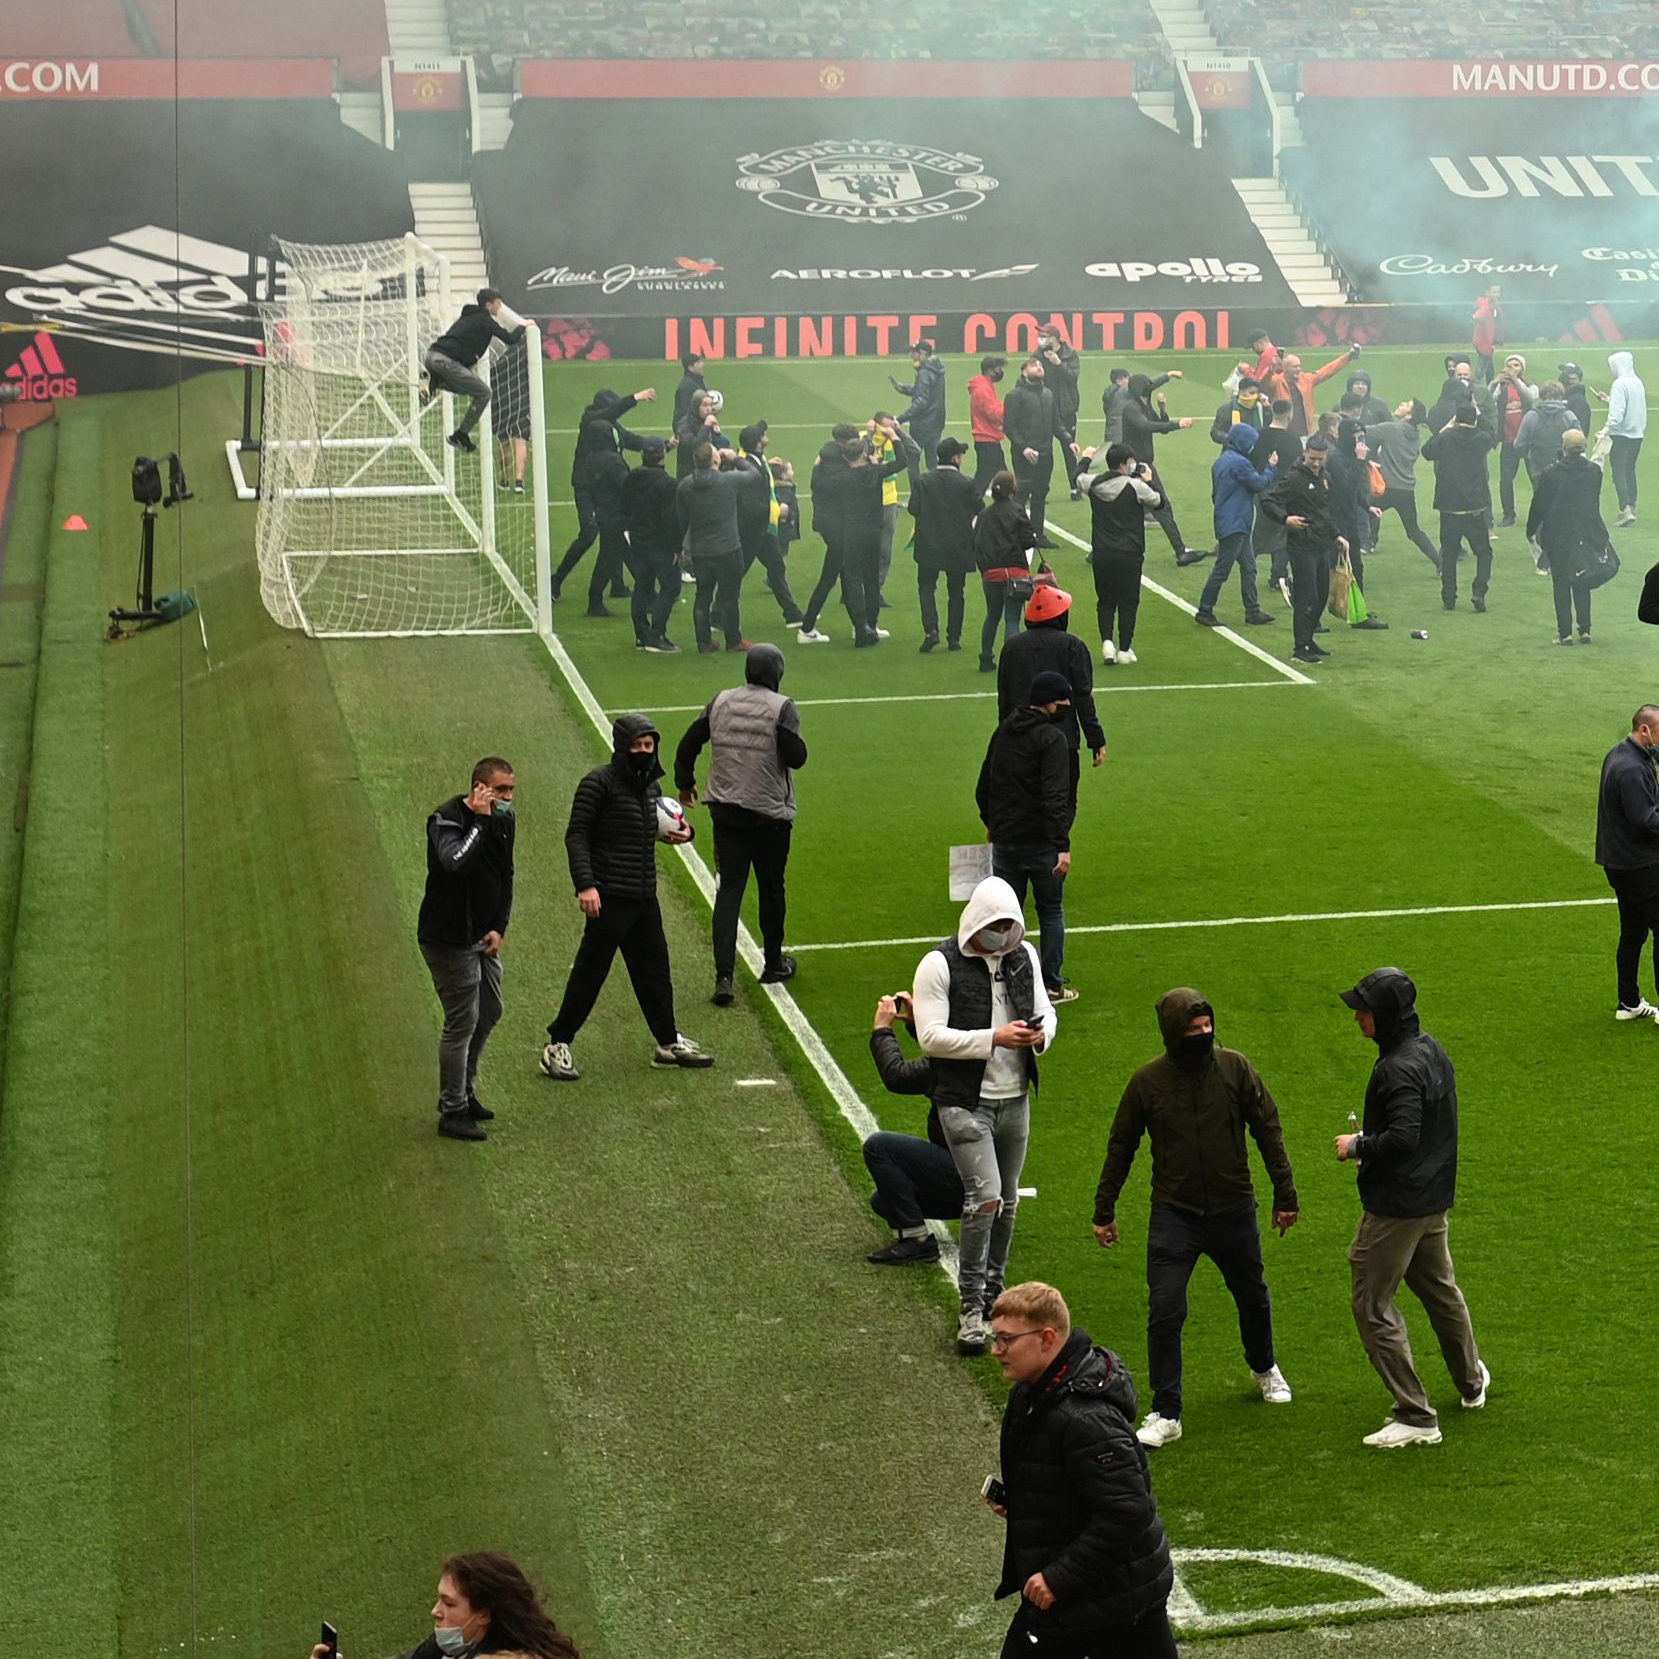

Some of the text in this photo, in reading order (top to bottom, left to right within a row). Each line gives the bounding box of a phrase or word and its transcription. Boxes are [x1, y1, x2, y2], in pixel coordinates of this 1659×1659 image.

[759, 143, 963, 173] MANCHESTER
[805, 198, 951, 218] UNITED
[527, 265, 597, 284] Maui
[602, 263, 667, 294] Jim
[770, 268, 976, 280] AEROFLOT
[1085, 258, 1260, 283] apollo
[1379, 254, 1559, 278] Cadbury
[665, 311, 1230, 360] INFINITE CONTROL
[2, 375, 78, 400] didas
